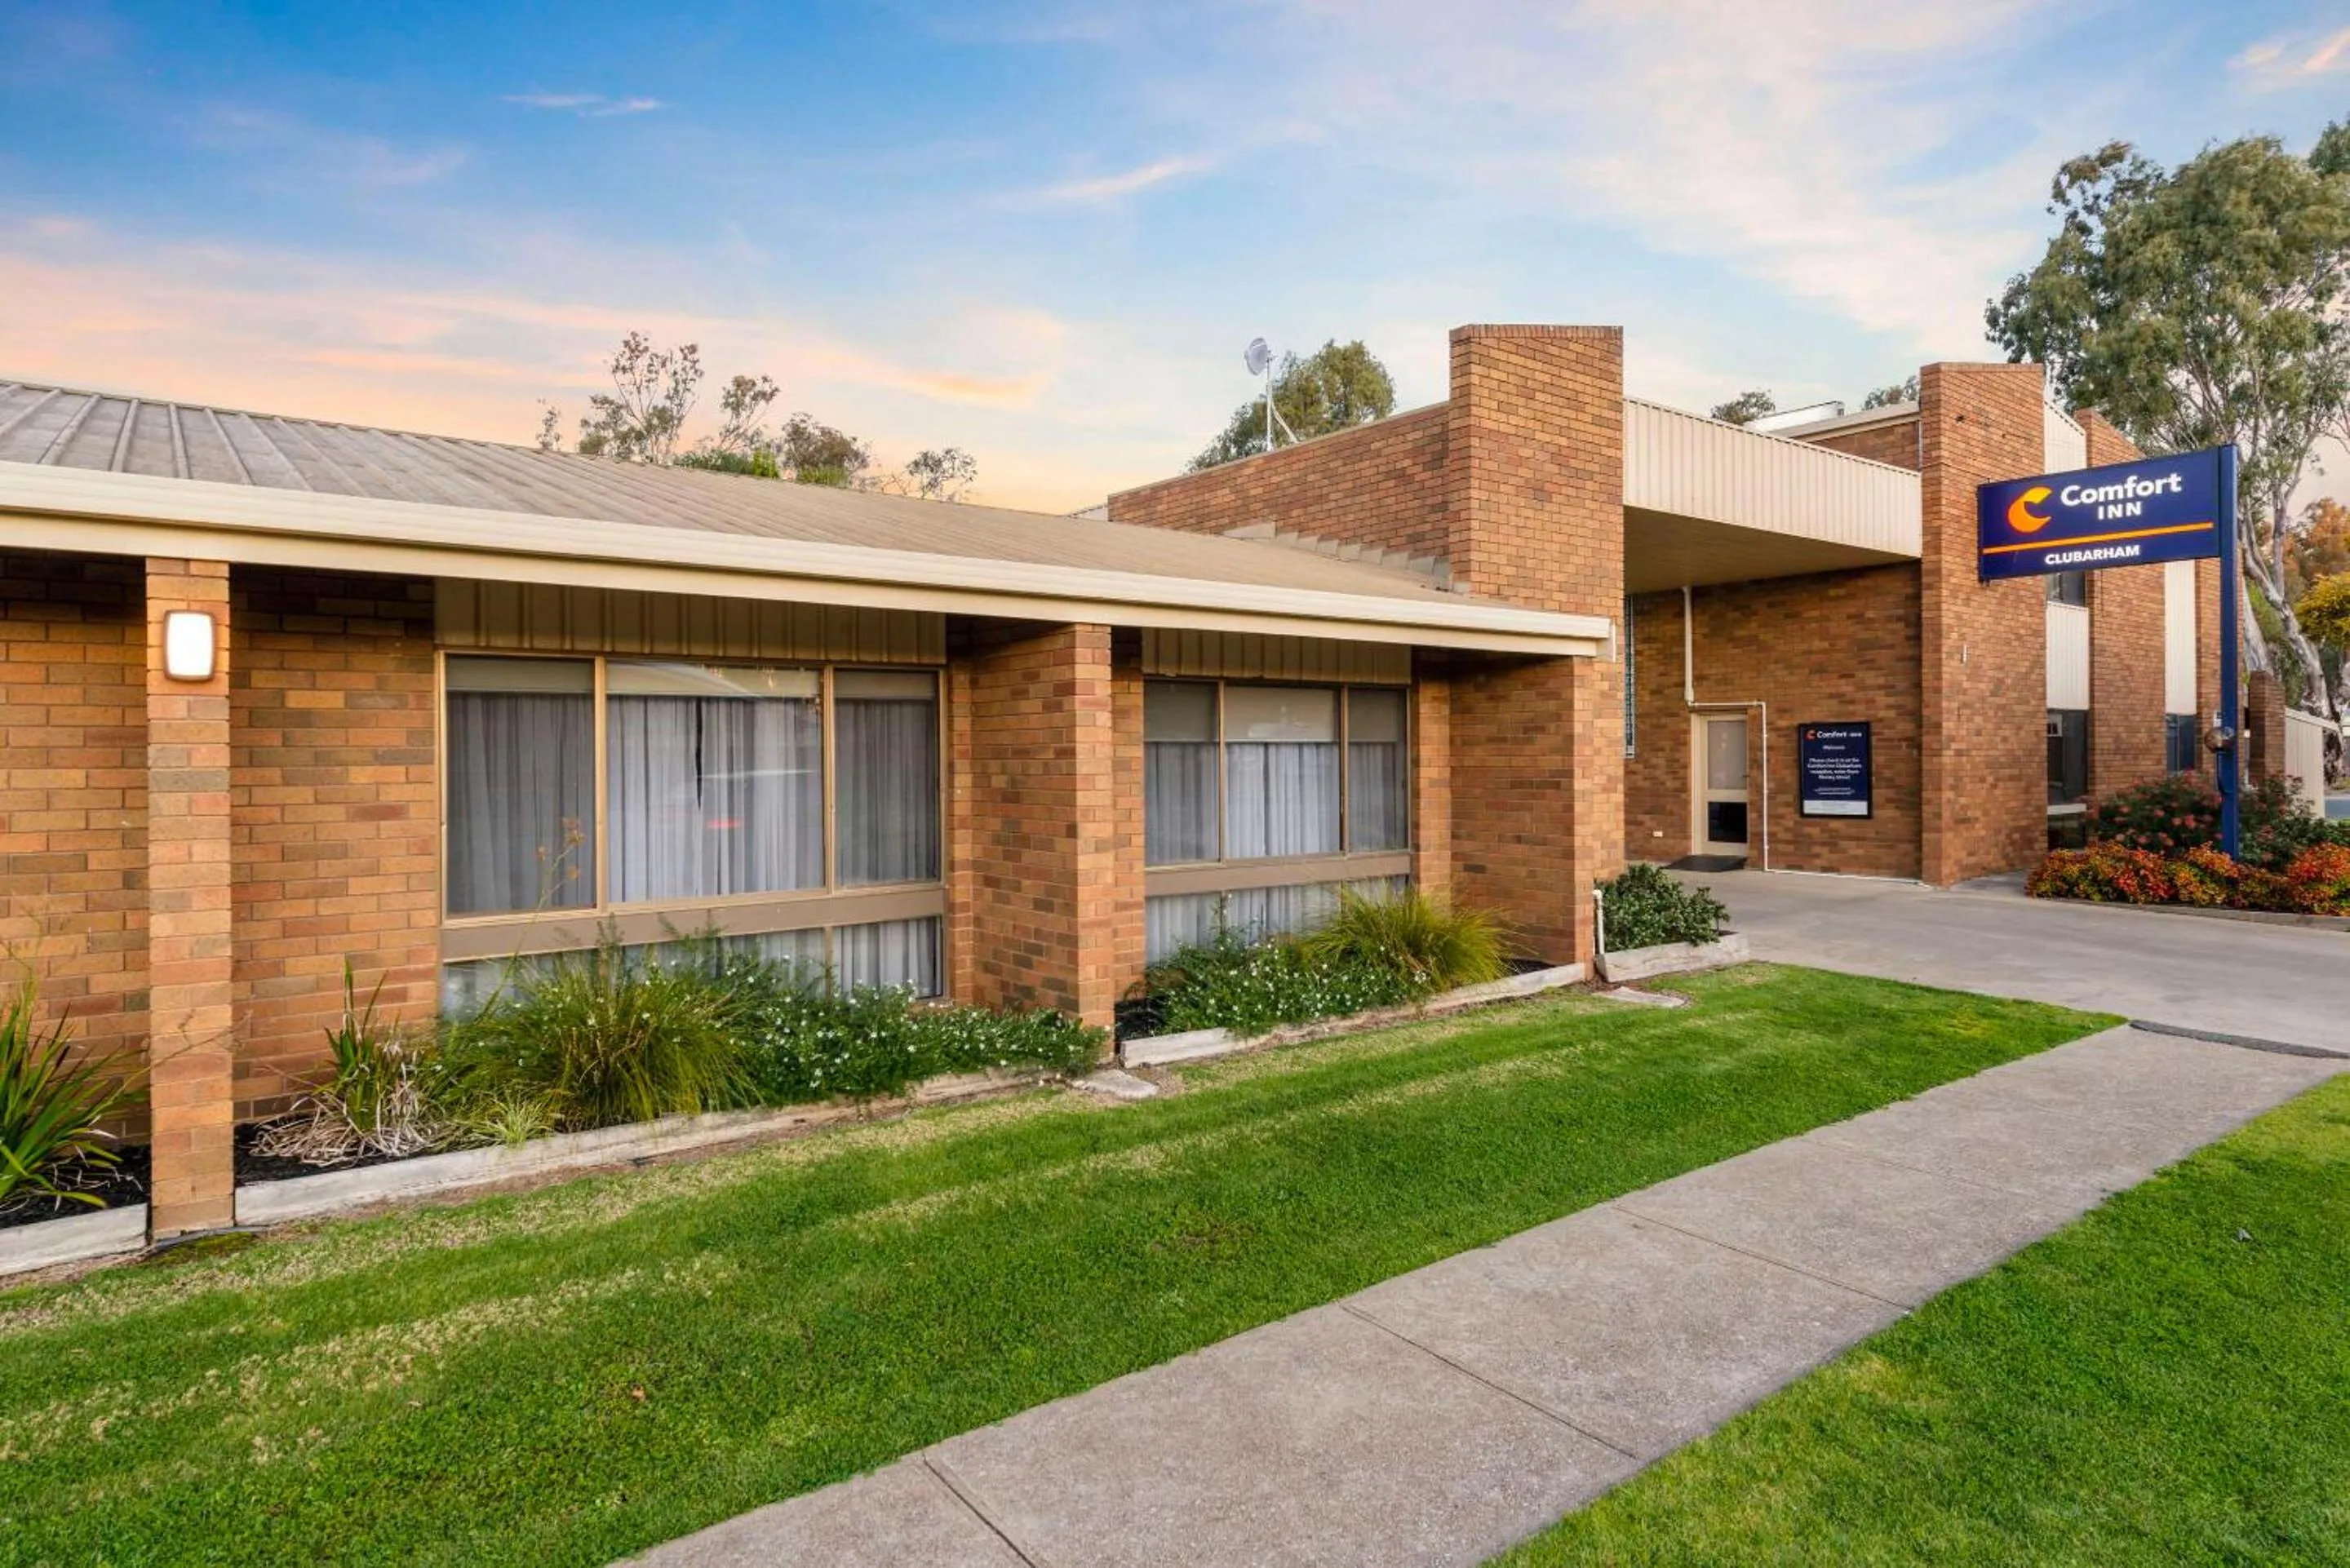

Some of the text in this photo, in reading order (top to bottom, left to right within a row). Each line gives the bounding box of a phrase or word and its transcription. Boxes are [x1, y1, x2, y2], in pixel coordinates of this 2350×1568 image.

[2060, 472, 2182, 507] Comfort
[2098, 501, 2142, 520] INN
[2045, 545, 2140, 565] CLUBARHAM
